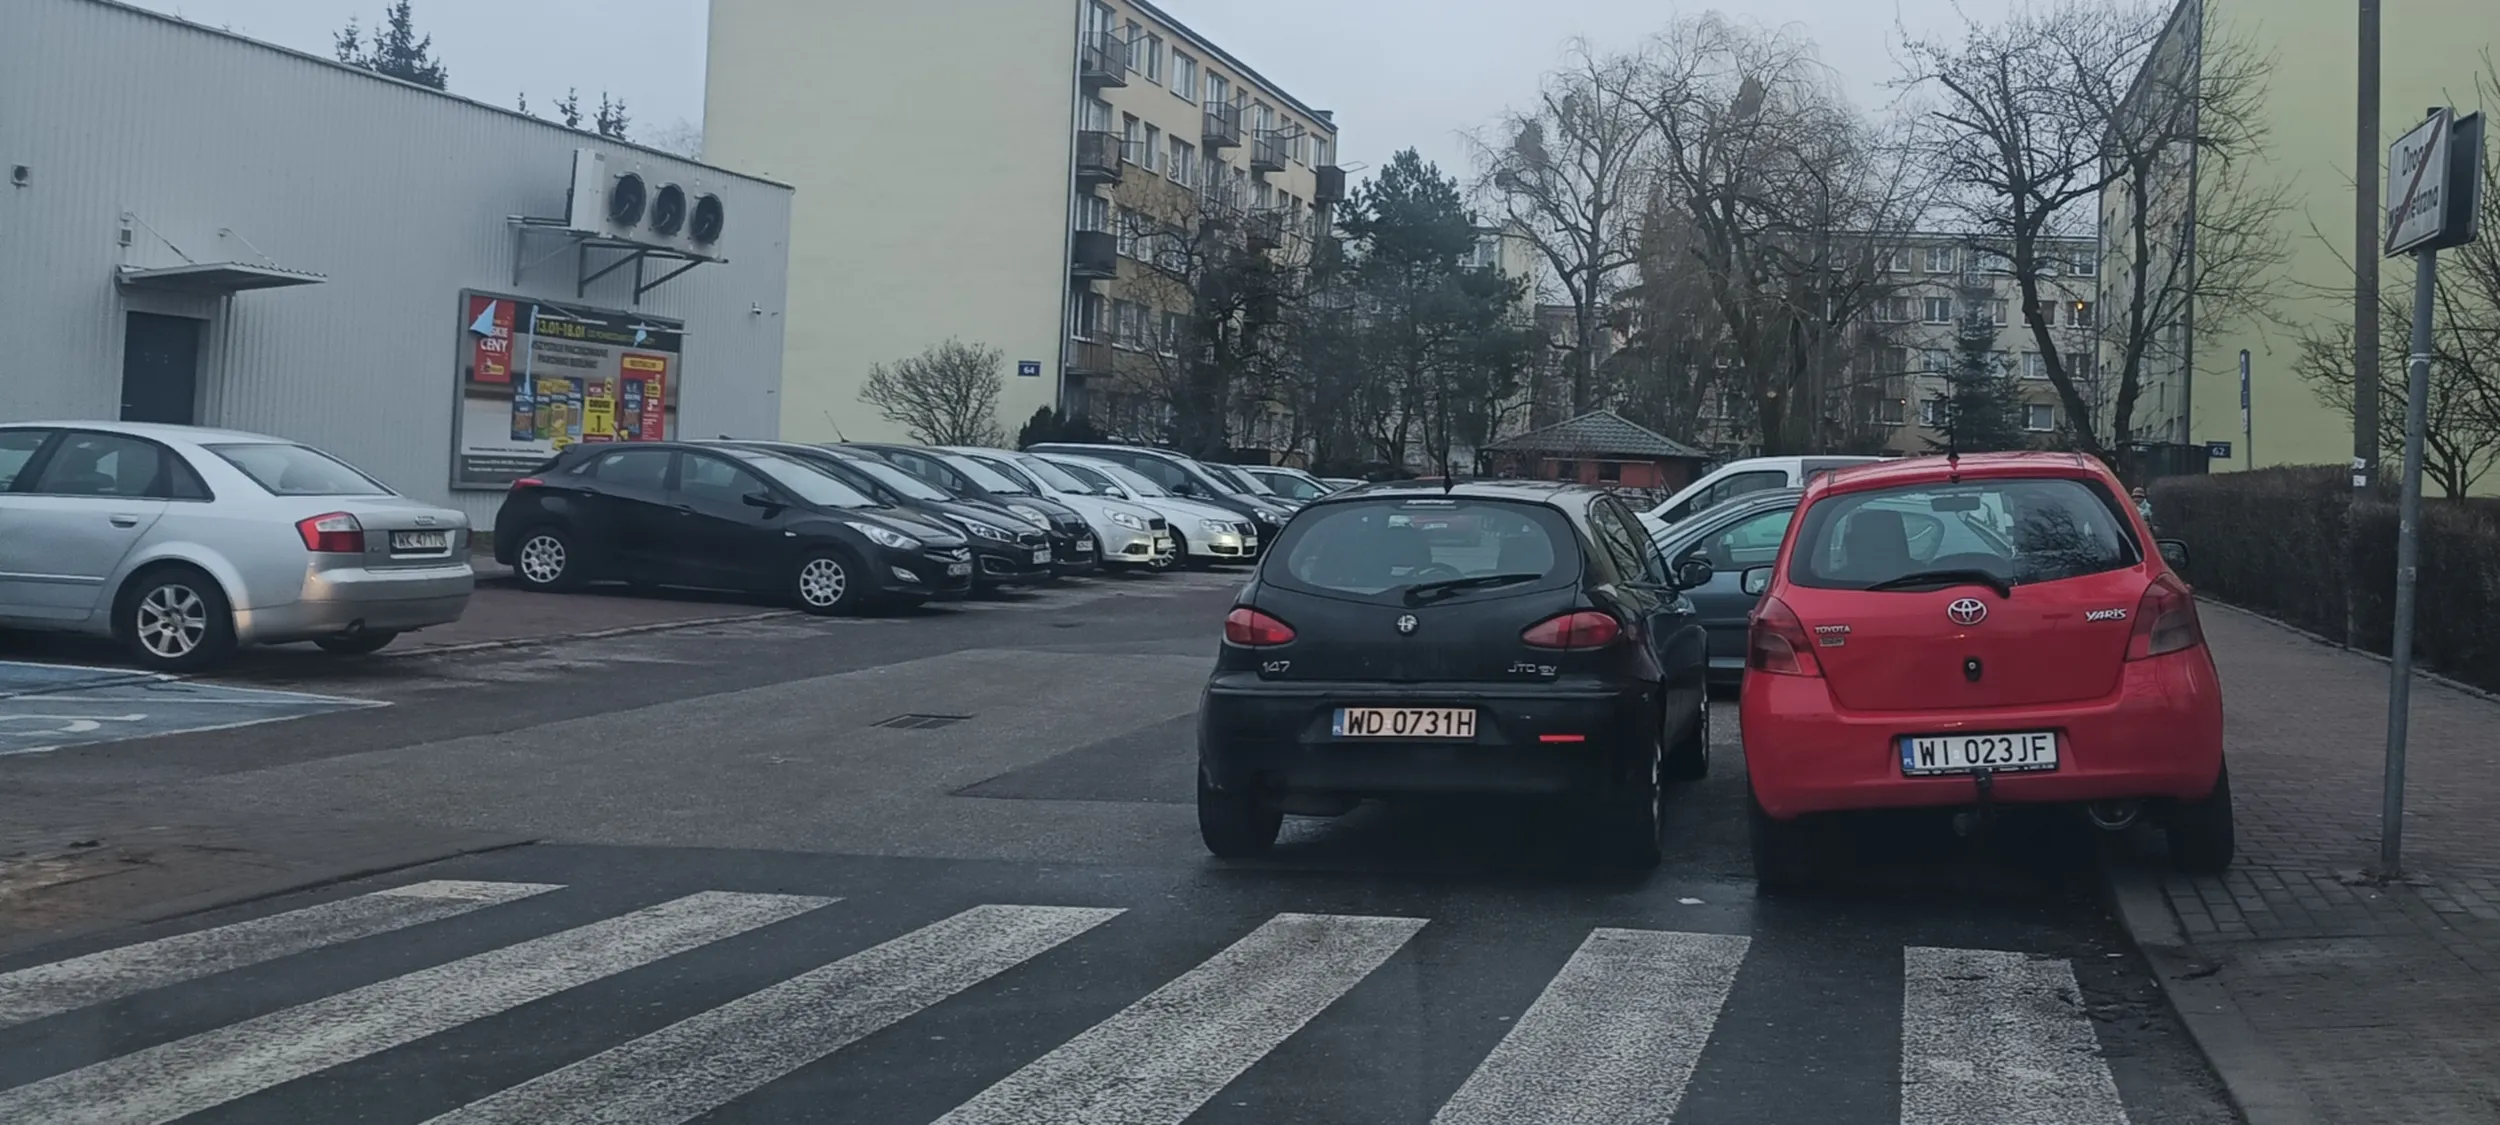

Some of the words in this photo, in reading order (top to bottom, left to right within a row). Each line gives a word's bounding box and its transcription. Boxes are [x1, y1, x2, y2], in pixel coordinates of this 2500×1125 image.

[2388, 185, 2439, 228] wenętrzna
[490, 325, 508, 338] SKIE
[480, 338, 508, 353] CENY
[1023, 366, 1035, 374] 64
[2212, 447, 2225, 456] 62
[1815, 625, 1850, 633] TOYOTA
[1262, 660, 1290, 672] 147
[1348, 710, 1384, 734] WD
[1393, 710, 1473, 735] 0731H
[1919, 739, 1949, 766] WI
[1965, 735, 2047, 765] 023JF
